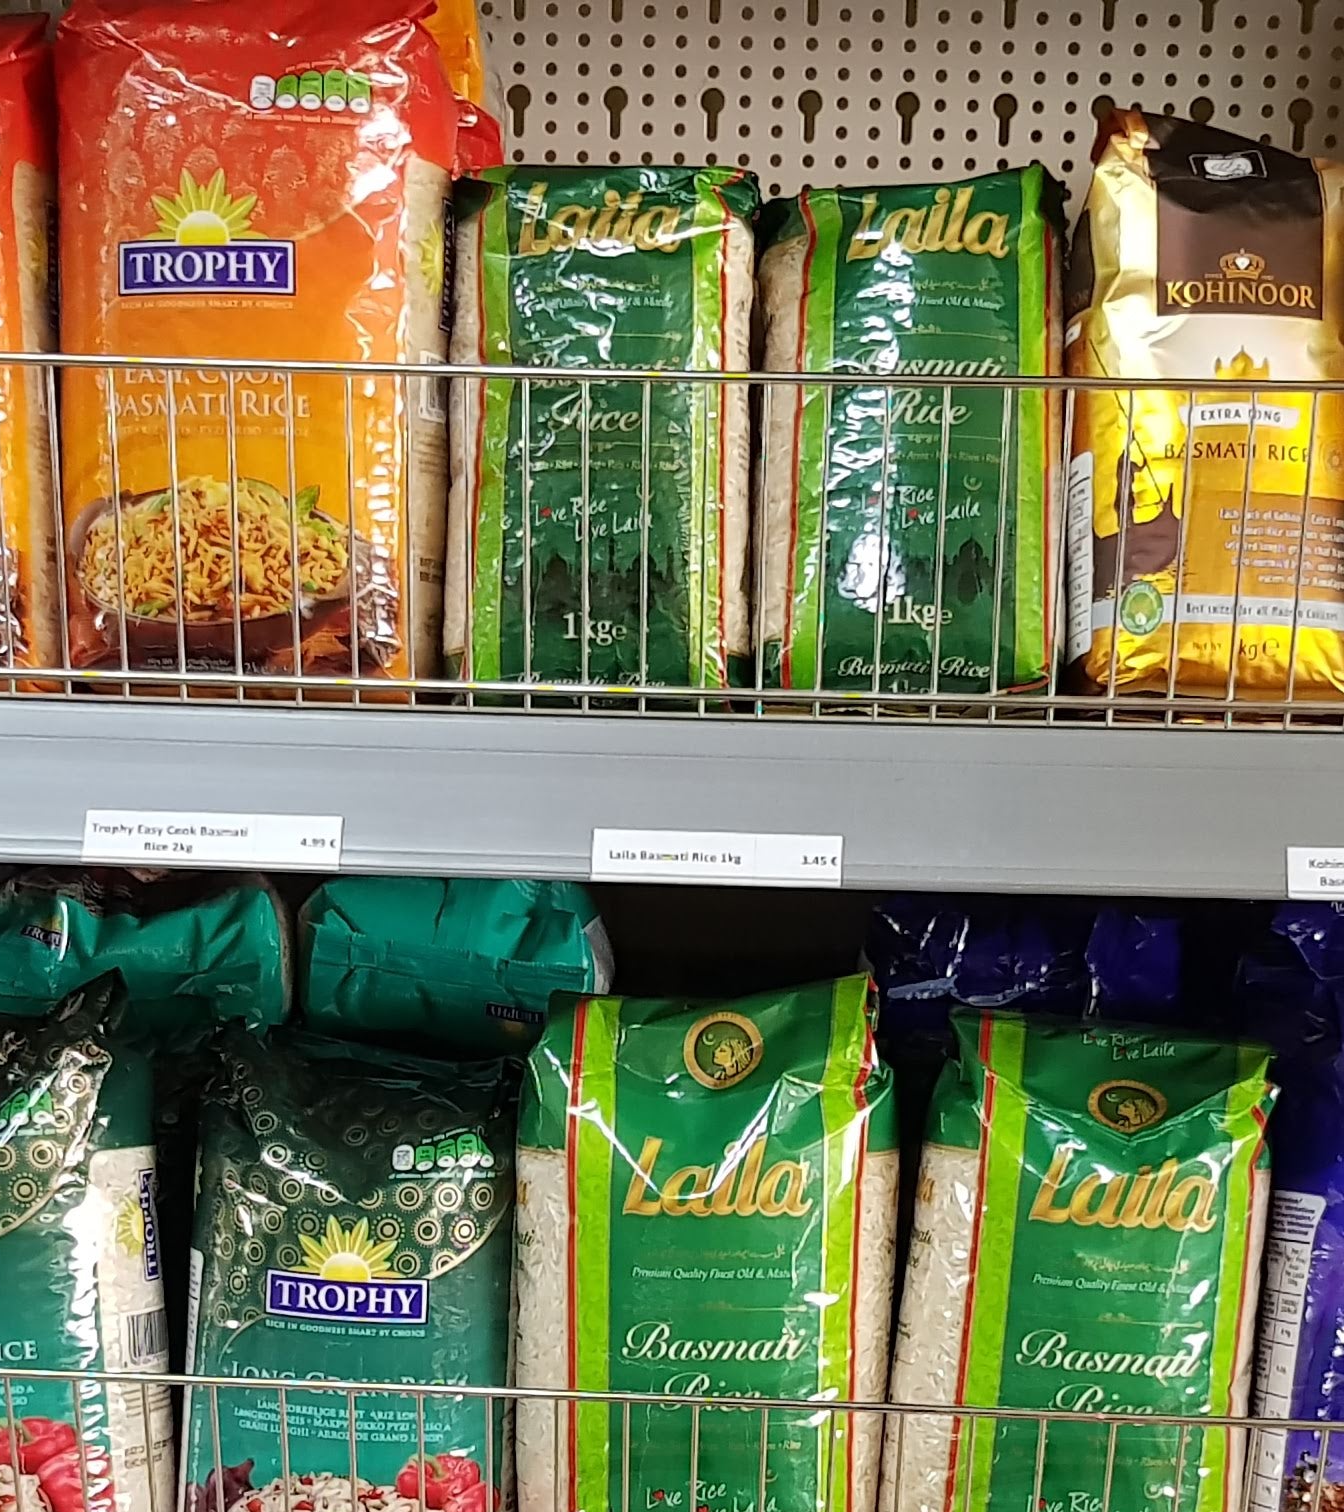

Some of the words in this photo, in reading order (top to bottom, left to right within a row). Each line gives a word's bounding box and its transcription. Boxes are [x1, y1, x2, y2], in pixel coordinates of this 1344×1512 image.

[846, 187, 1010, 263] Laila
[129, 250, 284, 286] TROPHY
[1165, 281, 1315, 310] KOHINOOR
[93, 823, 134, 836] Trophy
[138, 824, 162, 837] Easy
[173, 842, 193, 853] 2kg
[609, 850, 636, 860] Laila
[640, 850, 689, 861] Basmati
[692, 852, 717, 862] Rice
[721, 854, 741, 865] 1kg
[623, 1137, 812, 1217] Laila
[1030, 1144, 1217, 1232] Laila
[275, 1280, 419, 1315] TROPHY
[623, 1321, 805, 1362] Basmati
[1017, 1330, 1201, 1378] Basmati
